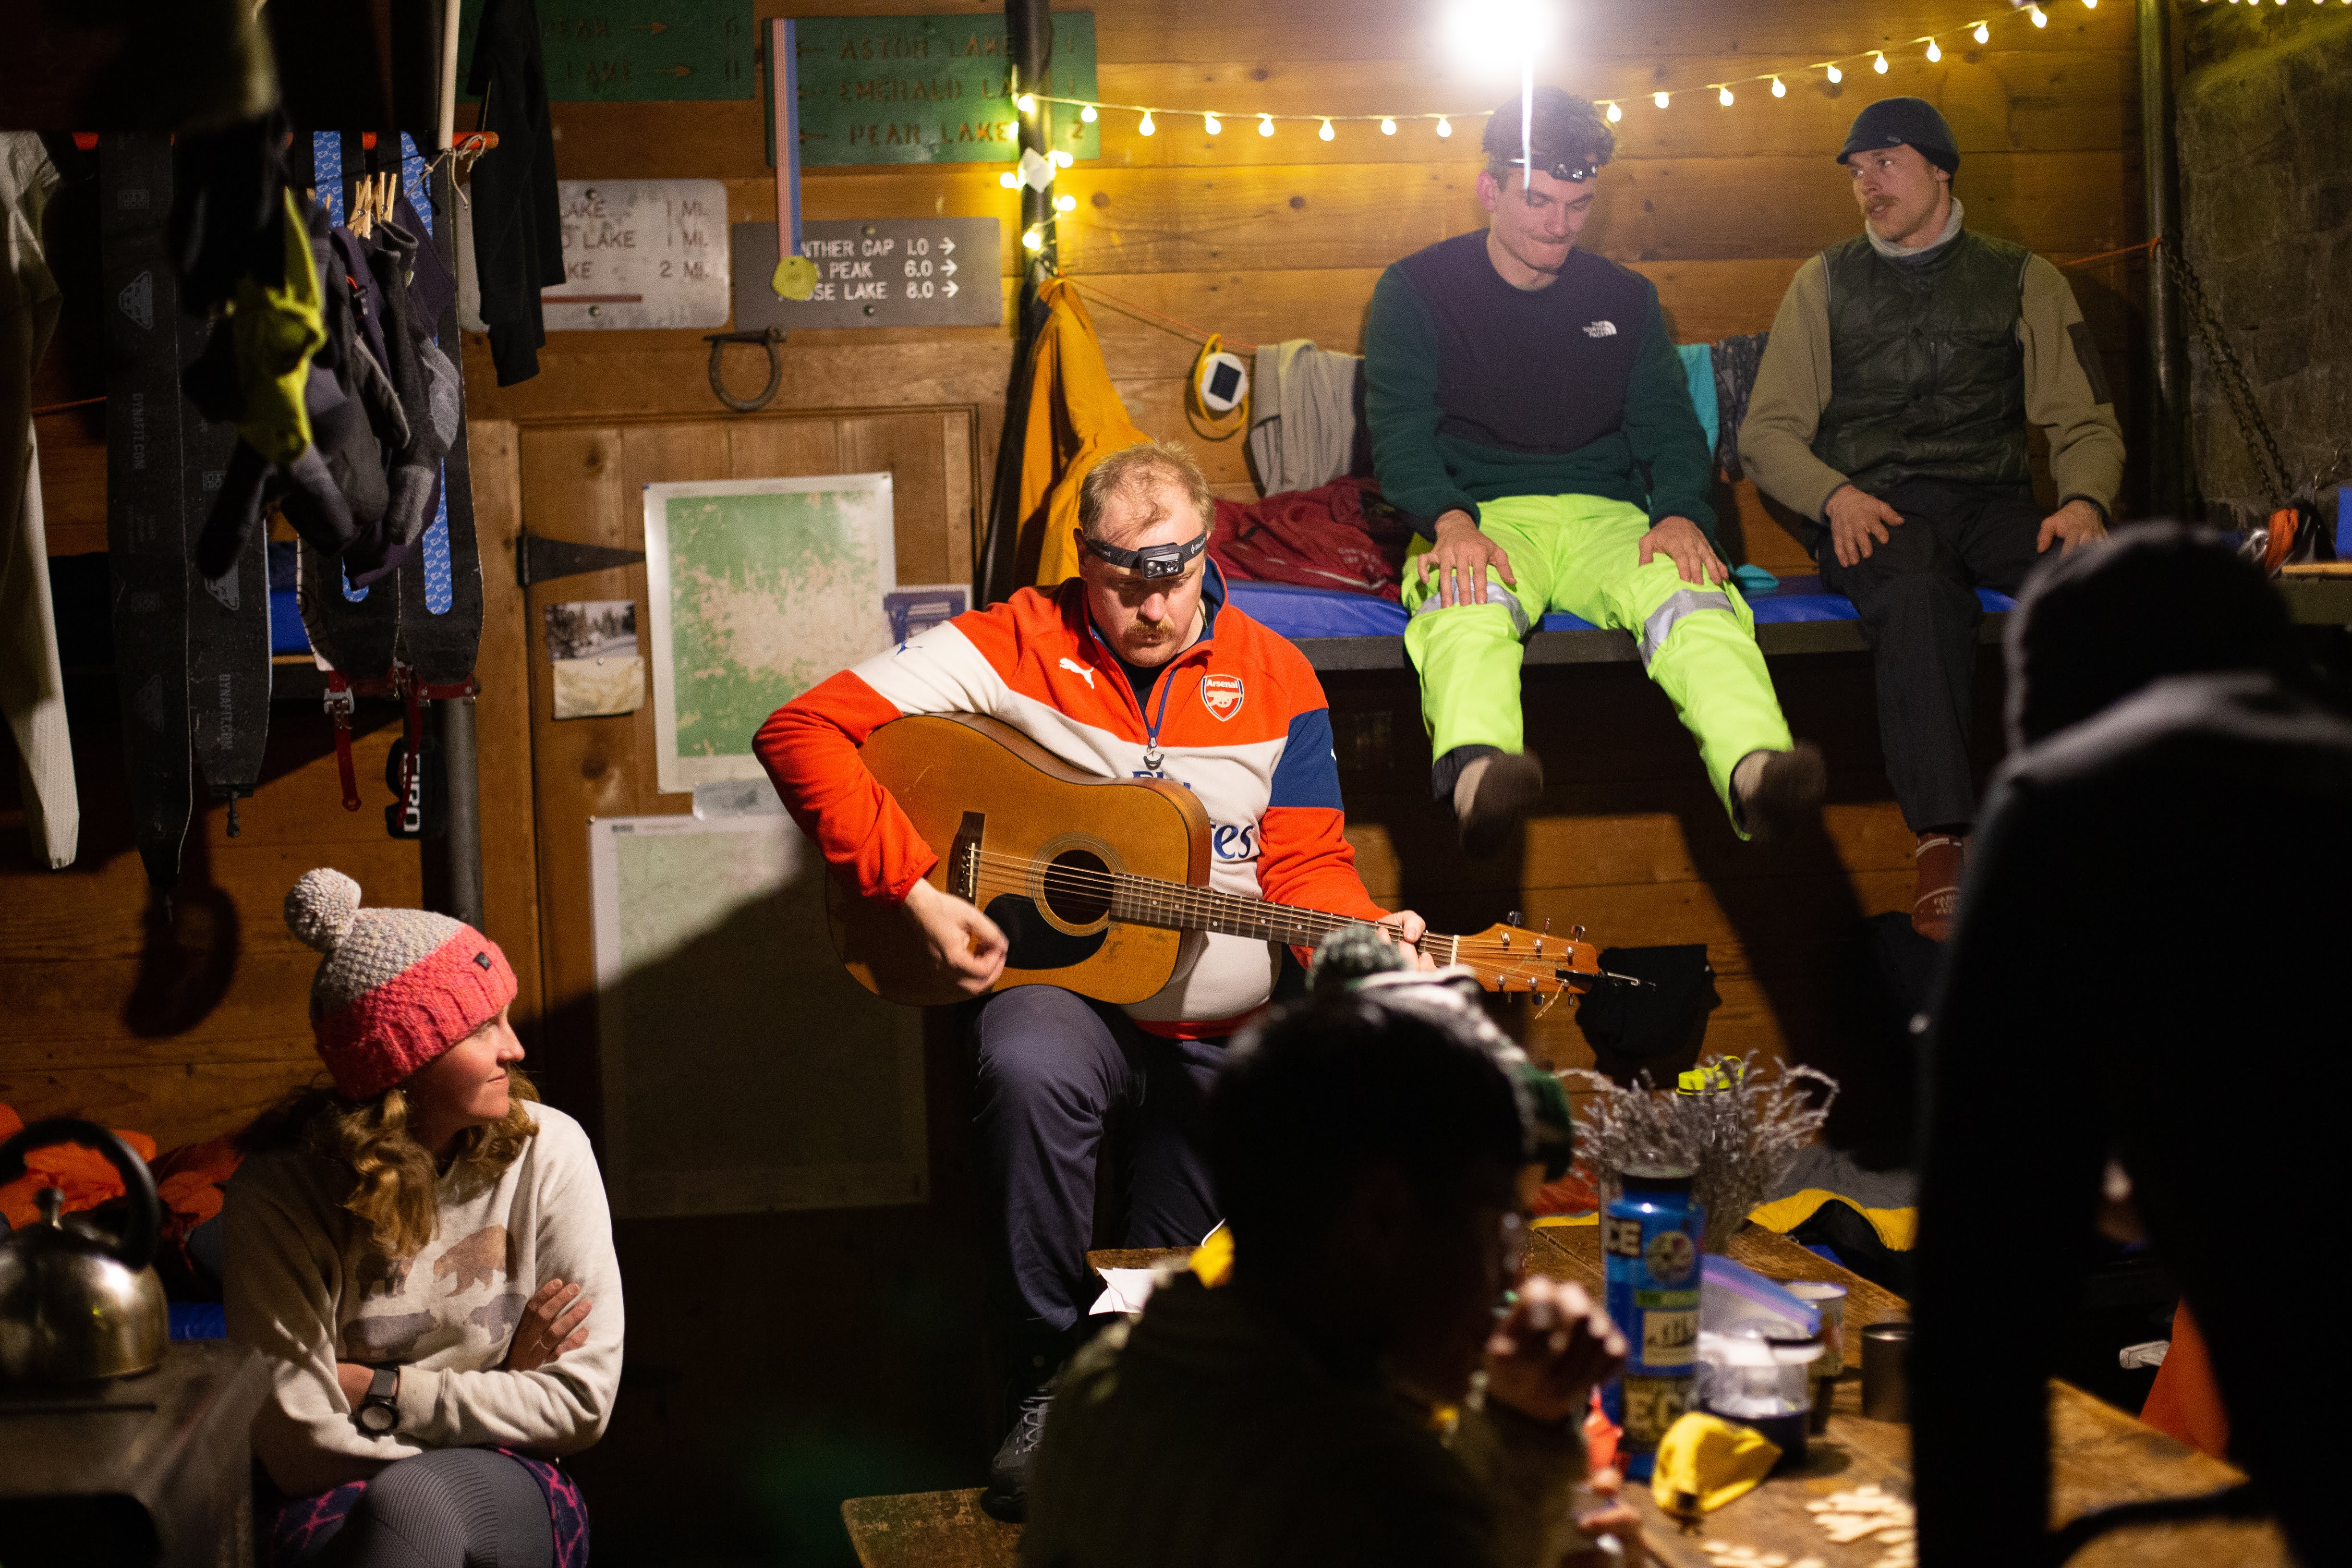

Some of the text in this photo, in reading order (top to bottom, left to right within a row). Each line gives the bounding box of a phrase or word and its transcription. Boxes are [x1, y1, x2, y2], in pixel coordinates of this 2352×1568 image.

[840, 77, 961, 101] EMERALD
[939, 120, 1008, 144] LAKE
[1072, 120, 1084, 139] 2
[582, 230, 636, 249] LAKE
[800, 240, 855, 258] NTHER
[862, 239, 895, 257] GAP
[659, 259, 672, 279] 2
[829, 261, 873, 280] PEAK
[904, 259, 934, 278] 6.0
[844, 281, 888, 301] LAKE
[905, 280, 935, 300] 8.0
[1206, 679, 1238, 689] Arsenal
[218, 673, 233, 751] DYNAFIT.COM
